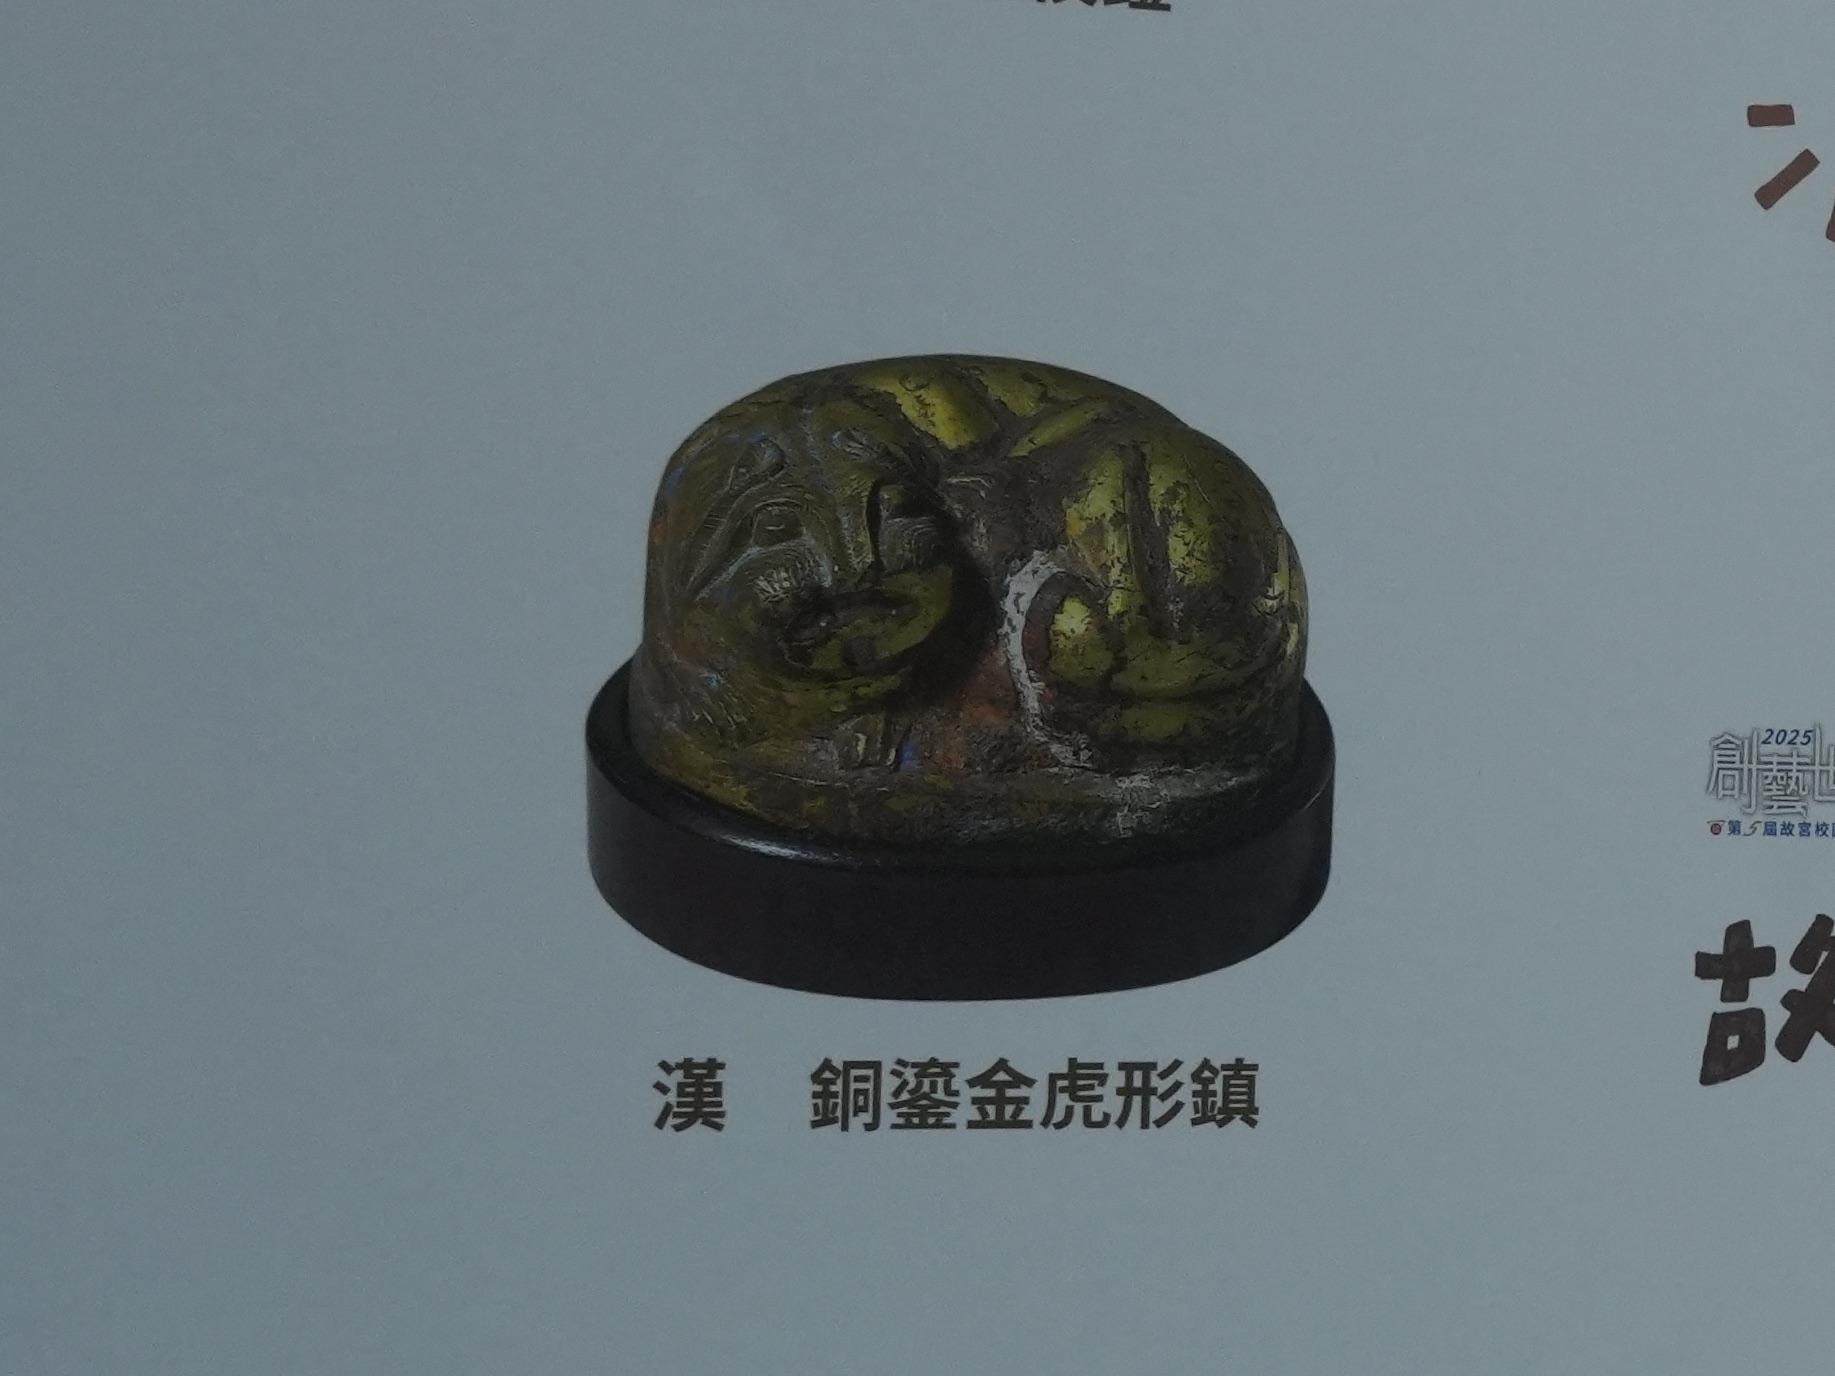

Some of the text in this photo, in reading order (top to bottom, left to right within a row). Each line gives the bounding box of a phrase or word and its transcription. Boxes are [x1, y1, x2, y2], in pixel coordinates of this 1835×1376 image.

[1761, 726, 1815, 746] 2025
[652, 1057, 1259, 1132] 漢 銅鎏金虎形鎮
